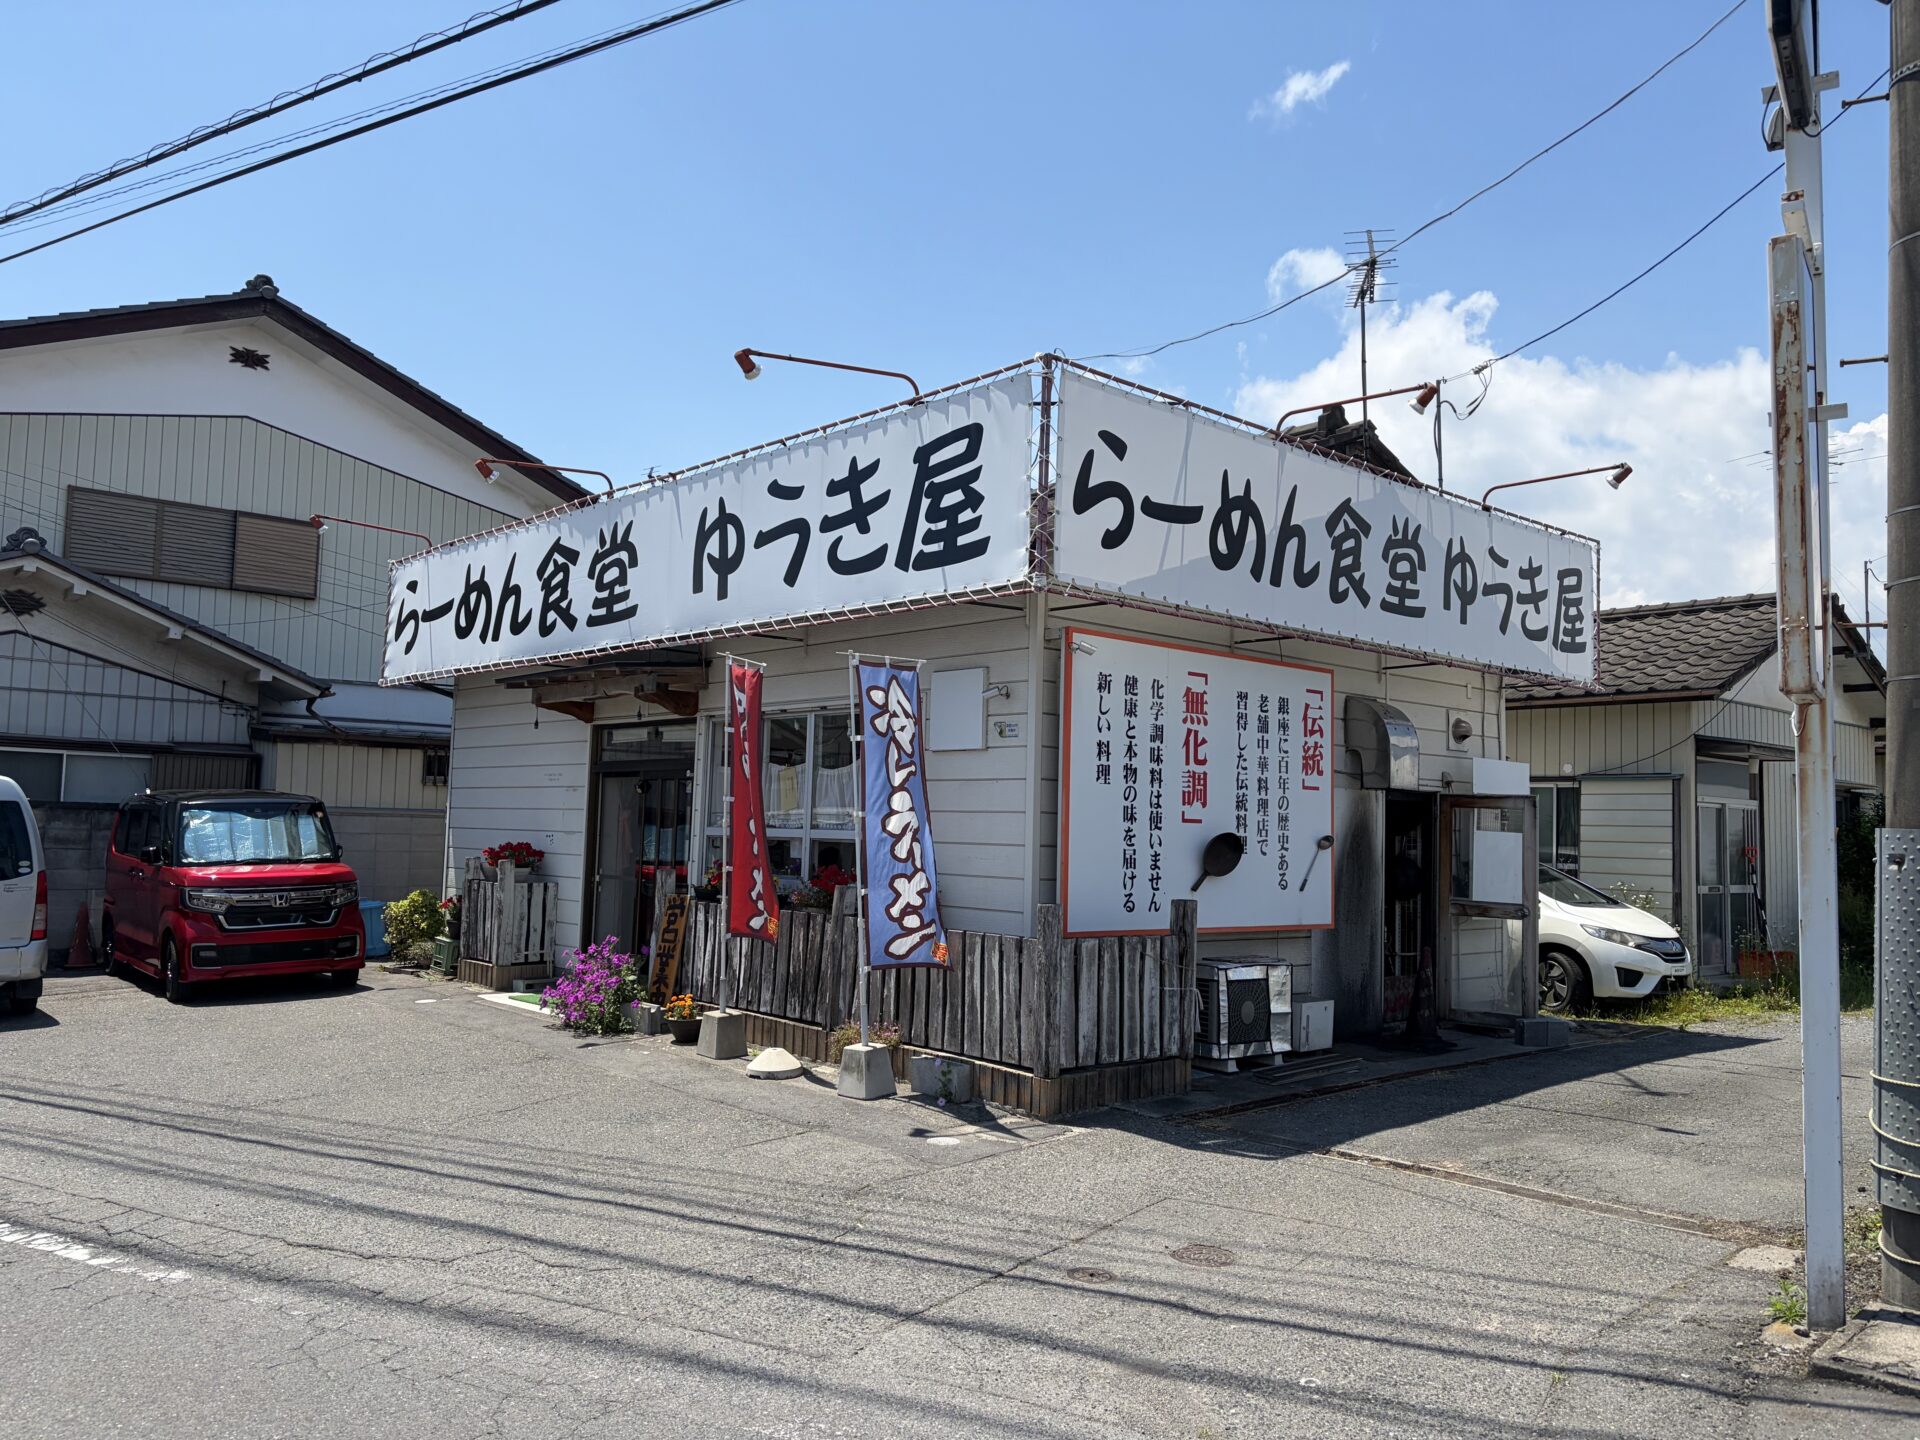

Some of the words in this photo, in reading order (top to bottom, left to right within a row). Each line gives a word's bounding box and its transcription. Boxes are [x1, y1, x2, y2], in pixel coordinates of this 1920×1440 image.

[394, 519, 639, 655] らーめん食堂
[692, 422, 991, 600] ゆうき屋
[1073, 430, 1427, 618] らーめん食堂
[1443, 536, 1588, 654] ゆうき屋
[1096, 672, 1113, 785] 新しい料理
[1122, 674, 1139, 913] 健康と本物の味を届ける
[1148, 678, 1165, 913] 化学調味料は使いません
[1181, 671, 1208, 824] 「無化調」
[1257, 693, 1270, 856] 老舗中華料理店で
[1277, 696, 1290, 890] 銀座に百年の歴史ある
[1301, 688, 1324, 791] 「伝統」
